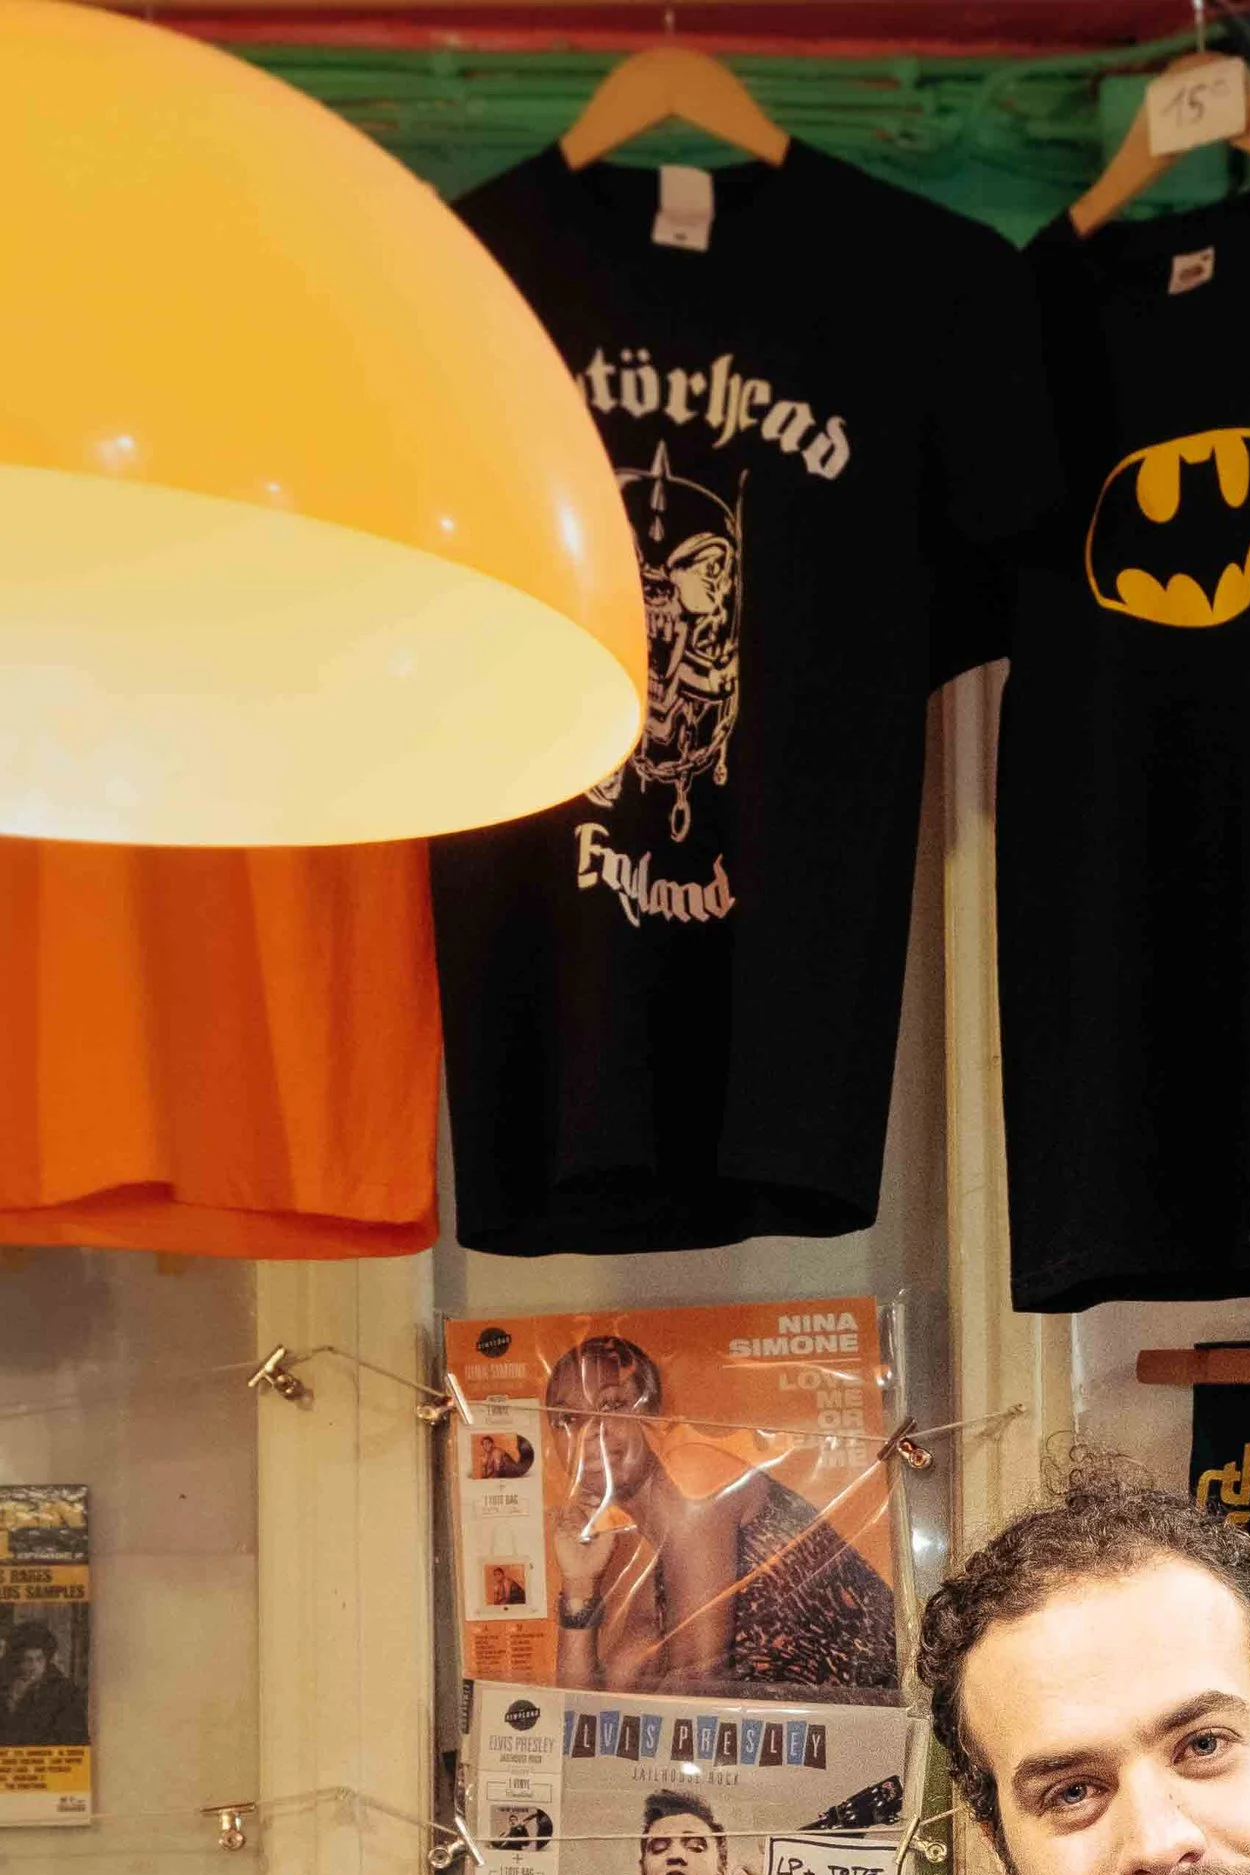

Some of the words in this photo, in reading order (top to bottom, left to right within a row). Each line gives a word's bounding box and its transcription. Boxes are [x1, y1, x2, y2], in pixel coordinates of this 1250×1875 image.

[576, 349, 851, 481] törhead
[573, 822, 736, 928] England
[777, 1312, 858, 1334] NINA
[728, 1333, 858, 1358] SIMONE
[817, 1388, 864, 1409] ME
[817, 1409, 864, 1429] OR
[515, 1736, 555, 1753] PRESLEY
[581, 1723, 655, 1757] LVIS
[678, 1725, 820, 1759] PRESLEY
